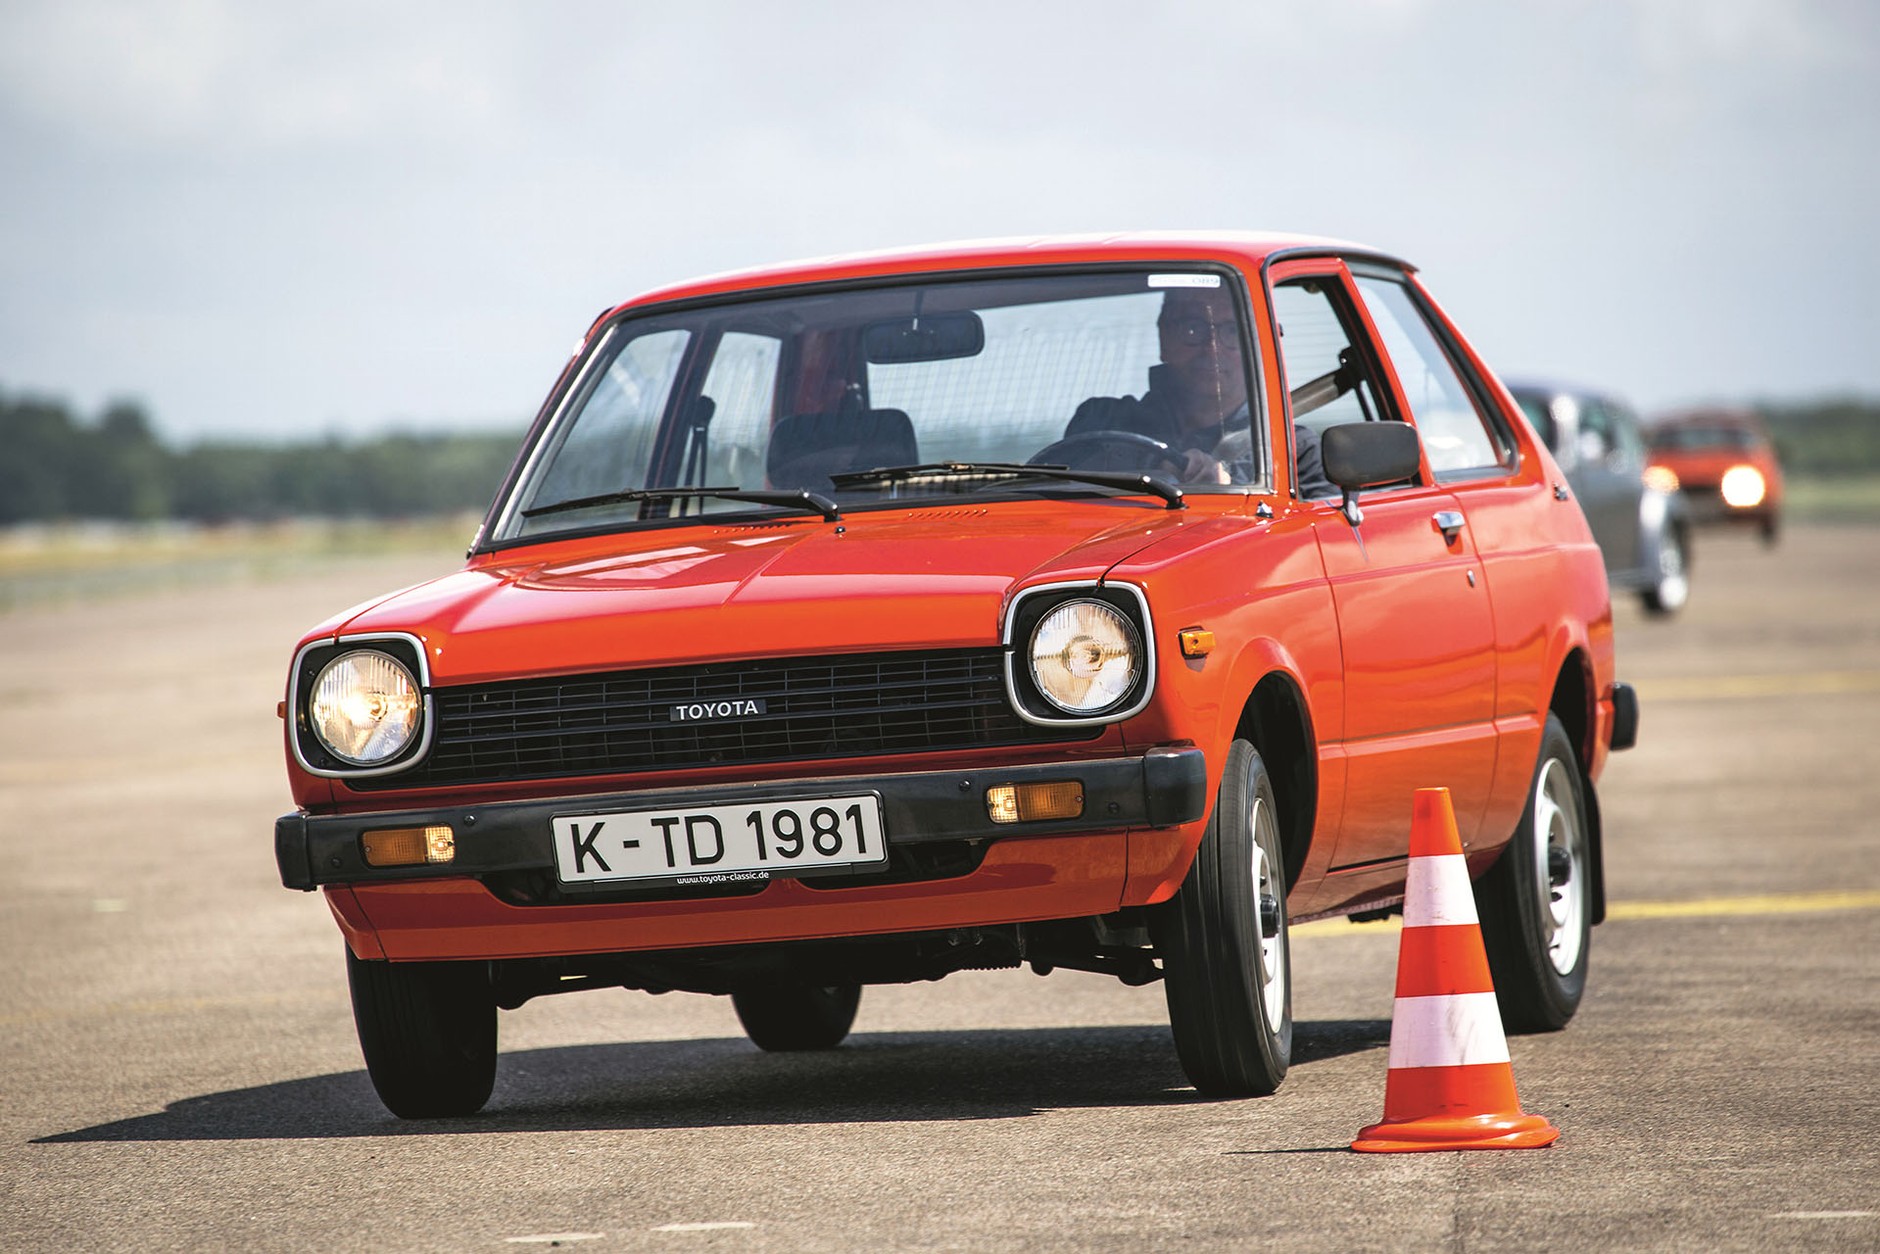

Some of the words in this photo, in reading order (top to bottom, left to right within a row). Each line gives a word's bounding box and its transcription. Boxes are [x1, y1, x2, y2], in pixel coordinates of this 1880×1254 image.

[676, 700, 759, 720] TOYOTA
[746, 804, 867, 861] 1981
[676, 871, 770, 885] www.toyota-classic.de
